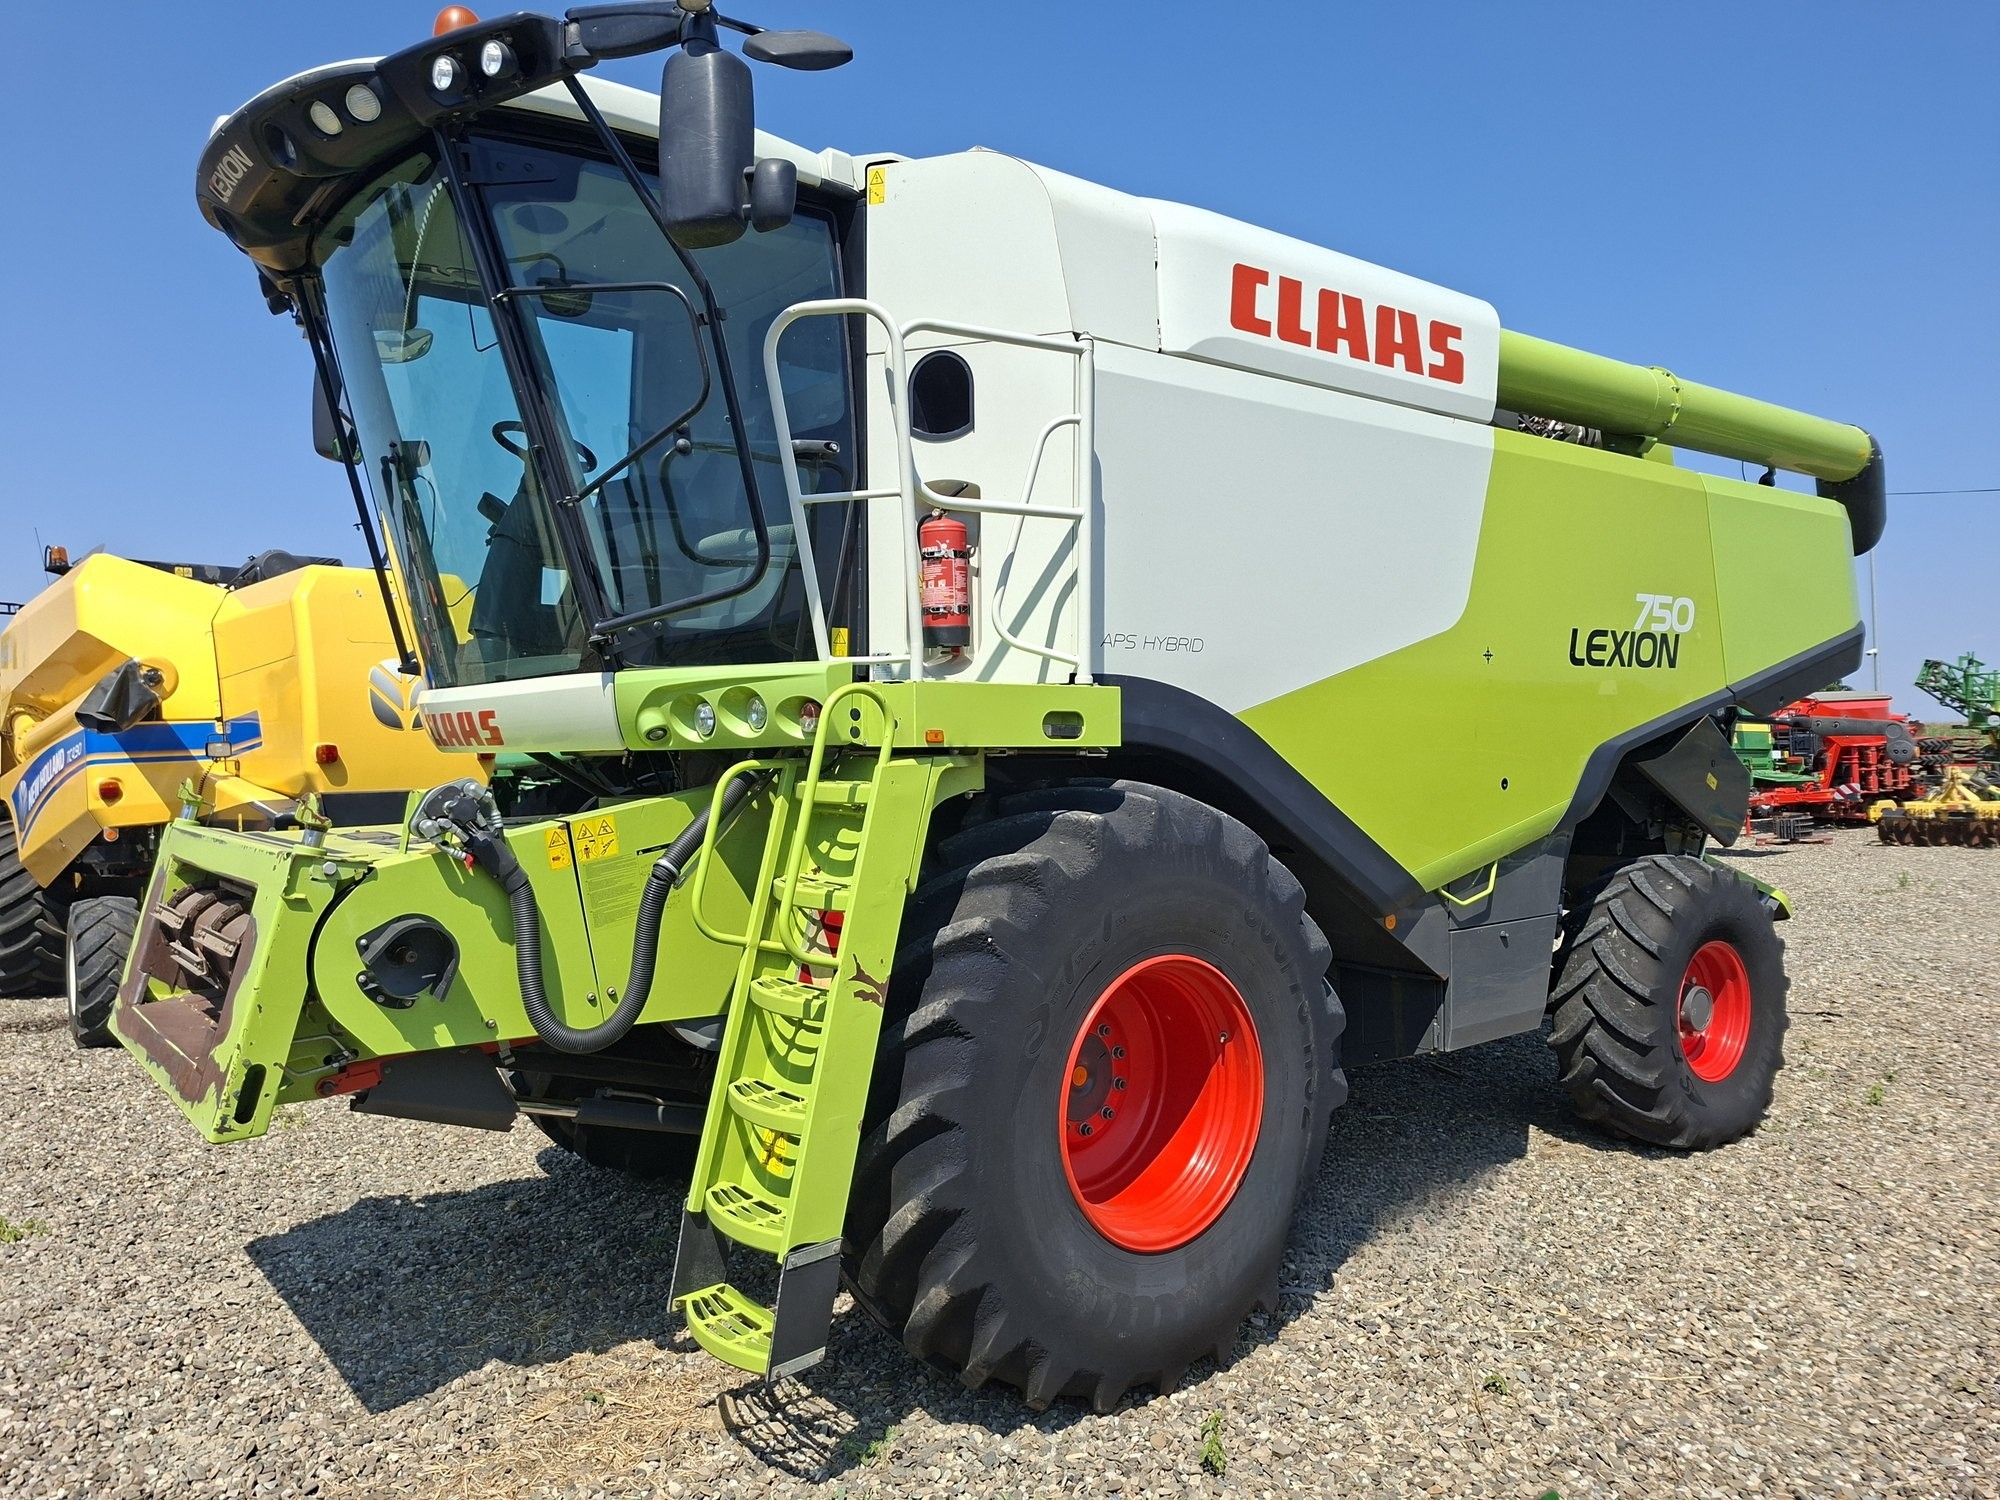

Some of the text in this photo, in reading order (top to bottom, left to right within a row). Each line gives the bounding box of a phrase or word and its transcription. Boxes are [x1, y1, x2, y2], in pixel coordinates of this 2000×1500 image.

[208, 144, 254, 203] LEXION
[1230, 263, 1464, 385] CLAAS
[1633, 593, 1695, 633] 750
[1100, 633, 1204, 653] APS HYBRID
[1569, 628, 1680, 669] LEXION
